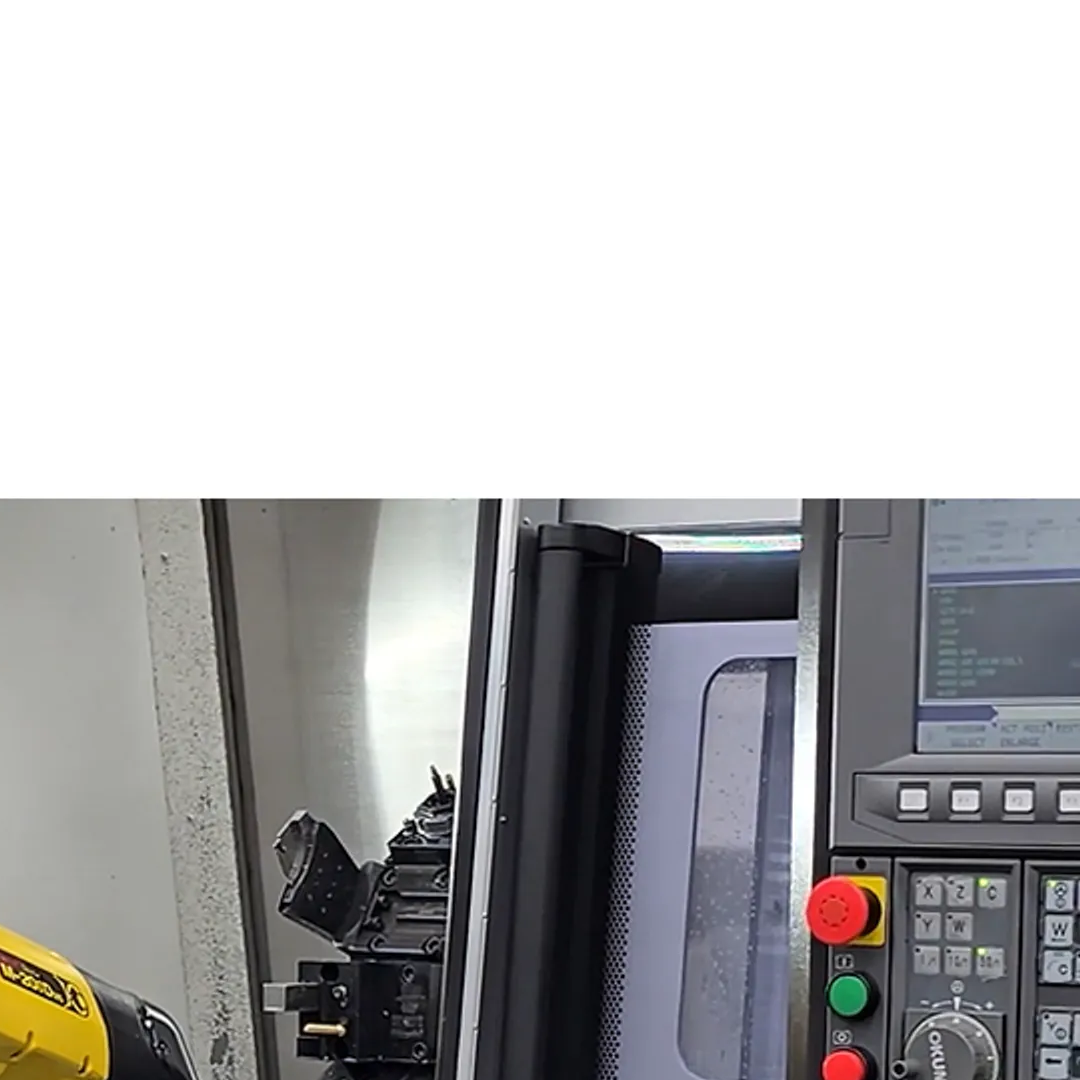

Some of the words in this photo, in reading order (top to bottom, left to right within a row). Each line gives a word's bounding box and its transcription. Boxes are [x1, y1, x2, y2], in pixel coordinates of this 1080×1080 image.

[923, 884, 934, 899] X
[987, 885, 998, 901] C
[922, 919, 933, 933] Y
[1052, 922, 1069, 937] W
